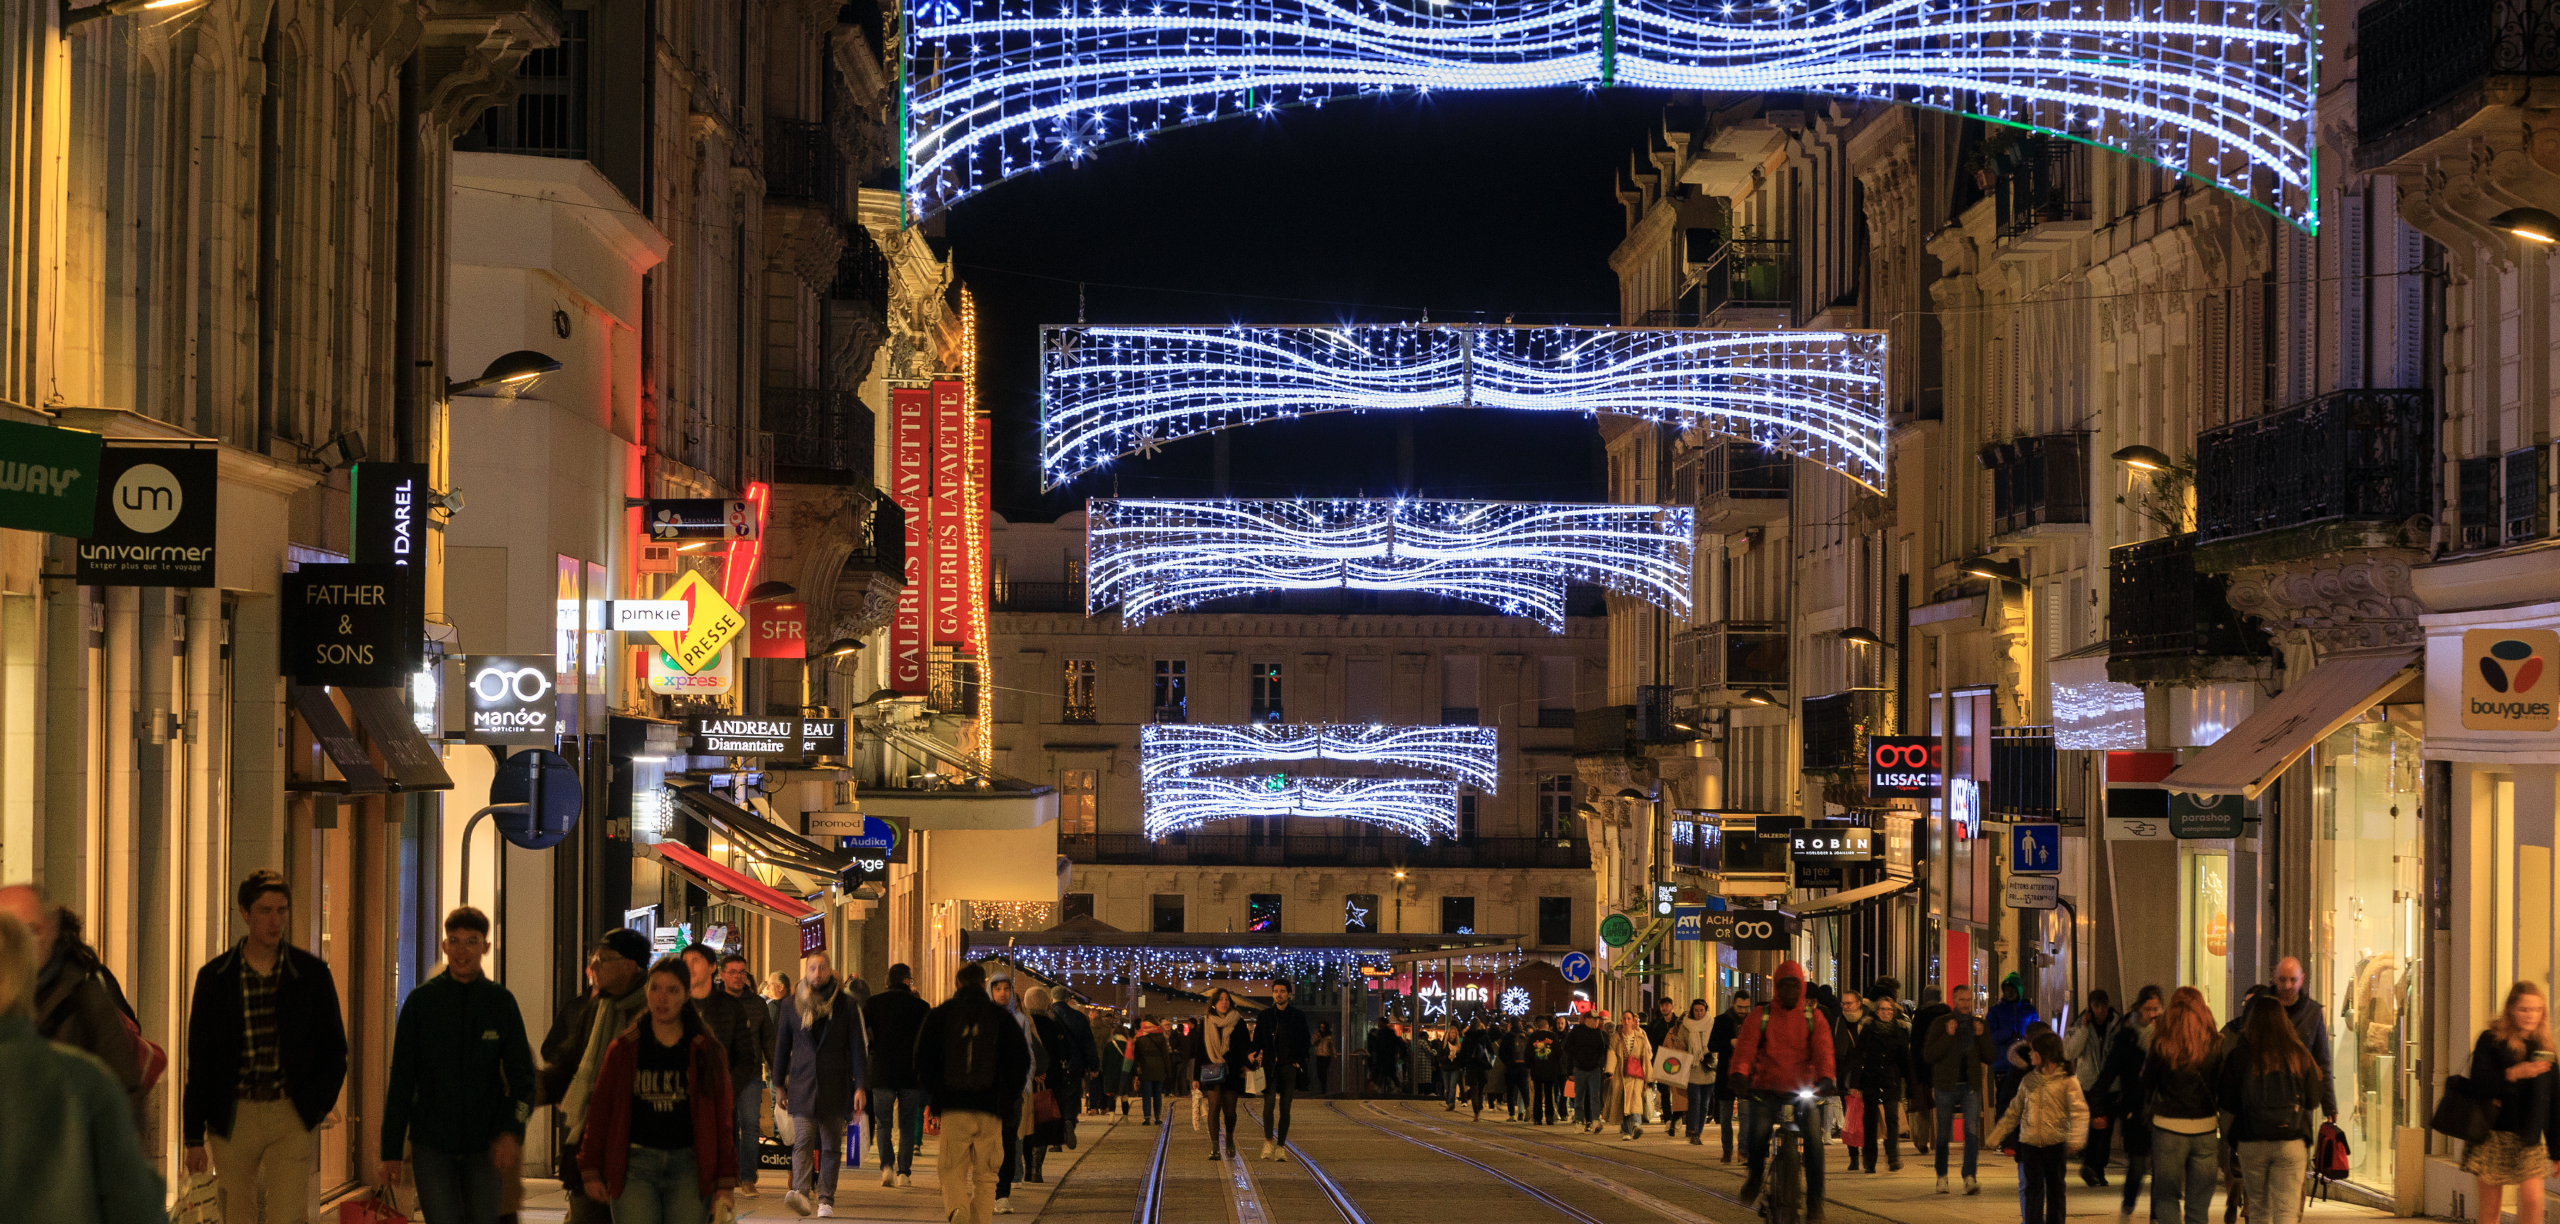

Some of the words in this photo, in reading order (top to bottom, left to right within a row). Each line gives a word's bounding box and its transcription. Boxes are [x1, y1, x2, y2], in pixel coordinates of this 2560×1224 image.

[939, 392, 958, 517] LAFAYETTE
[900, 401, 922, 548] LAFAYETTE
[394, 479, 412, 554] DAREL
[80, 545, 212, 561] univairmer
[90, 561, 116, 570] Exiger
[121, 562, 139, 570] plus
[143, 563, 157, 571] que
[174, 564, 202, 572] voyage
[939, 523, 958, 635] GALERIES
[306, 585, 386, 605] FATHER
[621, 608, 681, 622] pimkie
[898, 553, 921, 682] GALERIES
[338, 614, 352, 635] &
[761, 620, 802, 639] SFR
[684, 614, 736, 666] PRESSE
[316, 644, 374, 665] SONS
[652, 675, 727, 690] express
[2471, 697, 2550, 719] bouygues
[474, 708, 546, 725] Manéo
[701, 720, 792, 736] LANDREAU
[708, 738, 784, 752] Diamantaire
[1876, 773, 1927, 786] LISSAC
[812, 820, 860, 828] promod
[2181, 813, 2231, 824] parashop
[850, 838, 886, 846] Audika
[1795, 839, 1868, 849] ROBIN
[1715, 929, 1731, 938] OR
